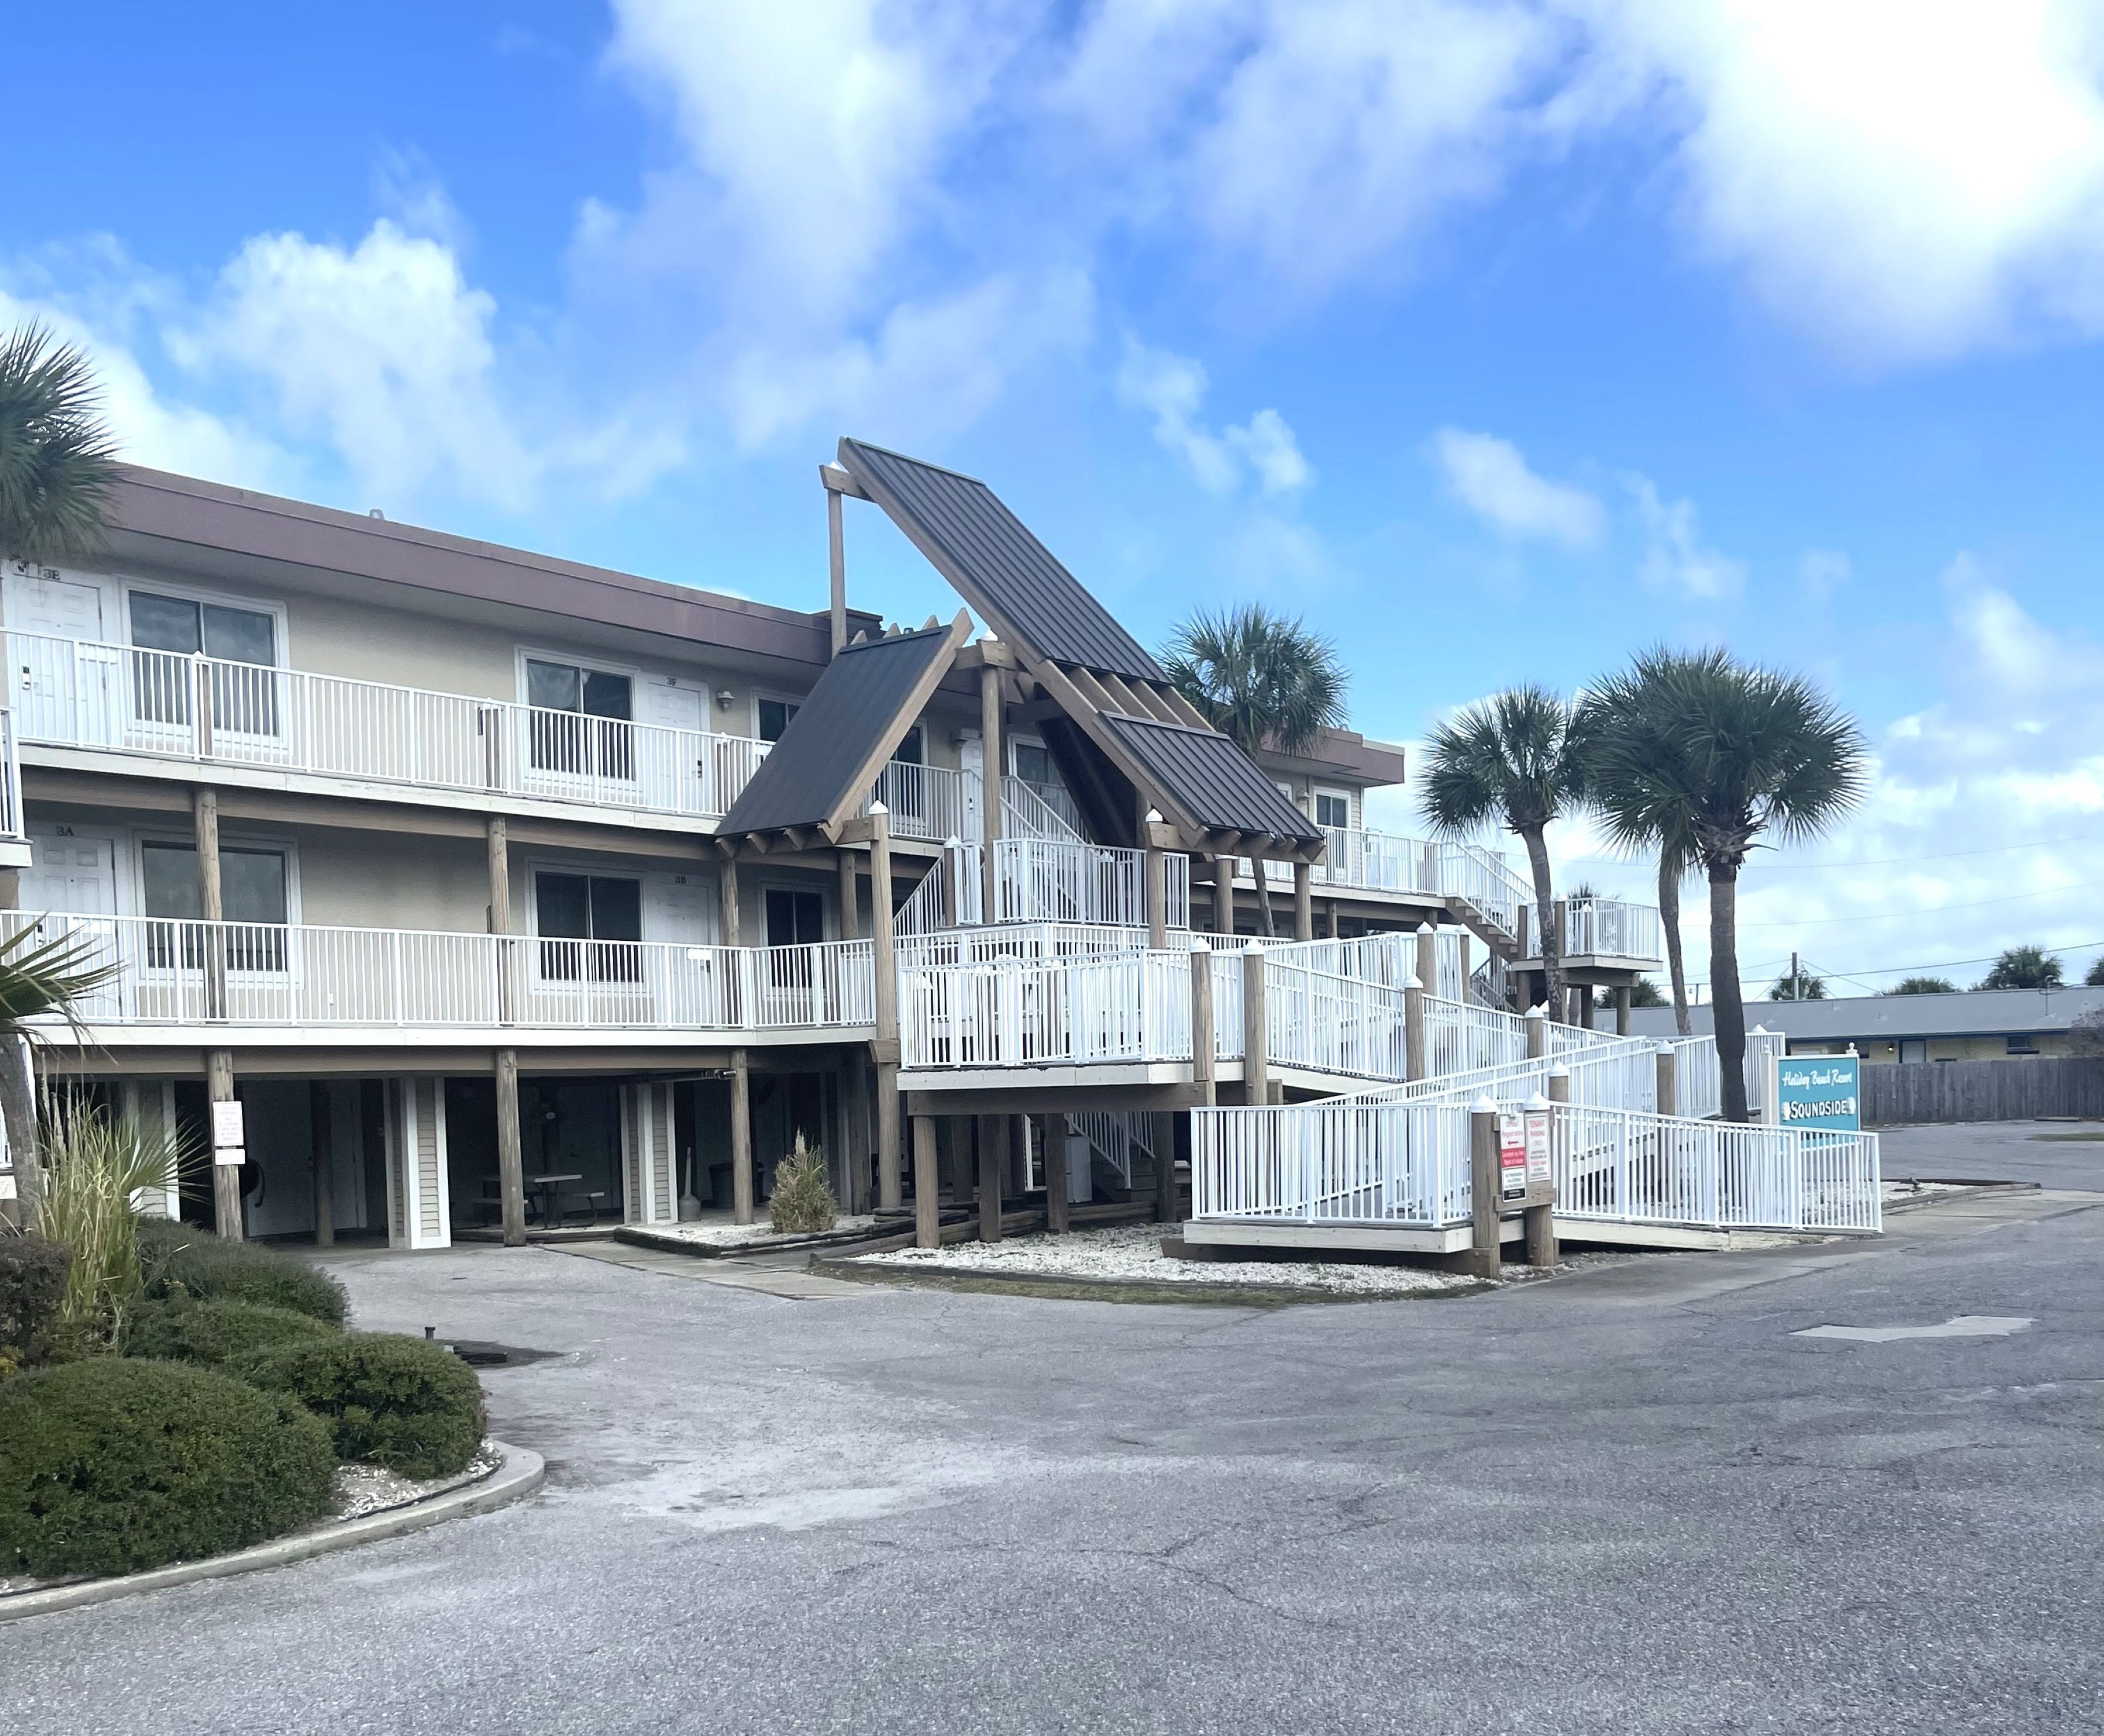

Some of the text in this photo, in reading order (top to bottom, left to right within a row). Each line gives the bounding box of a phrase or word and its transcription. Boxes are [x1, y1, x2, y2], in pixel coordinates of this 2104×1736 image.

[1782, 1069, 1852, 1090] Holiday Beach Resort
